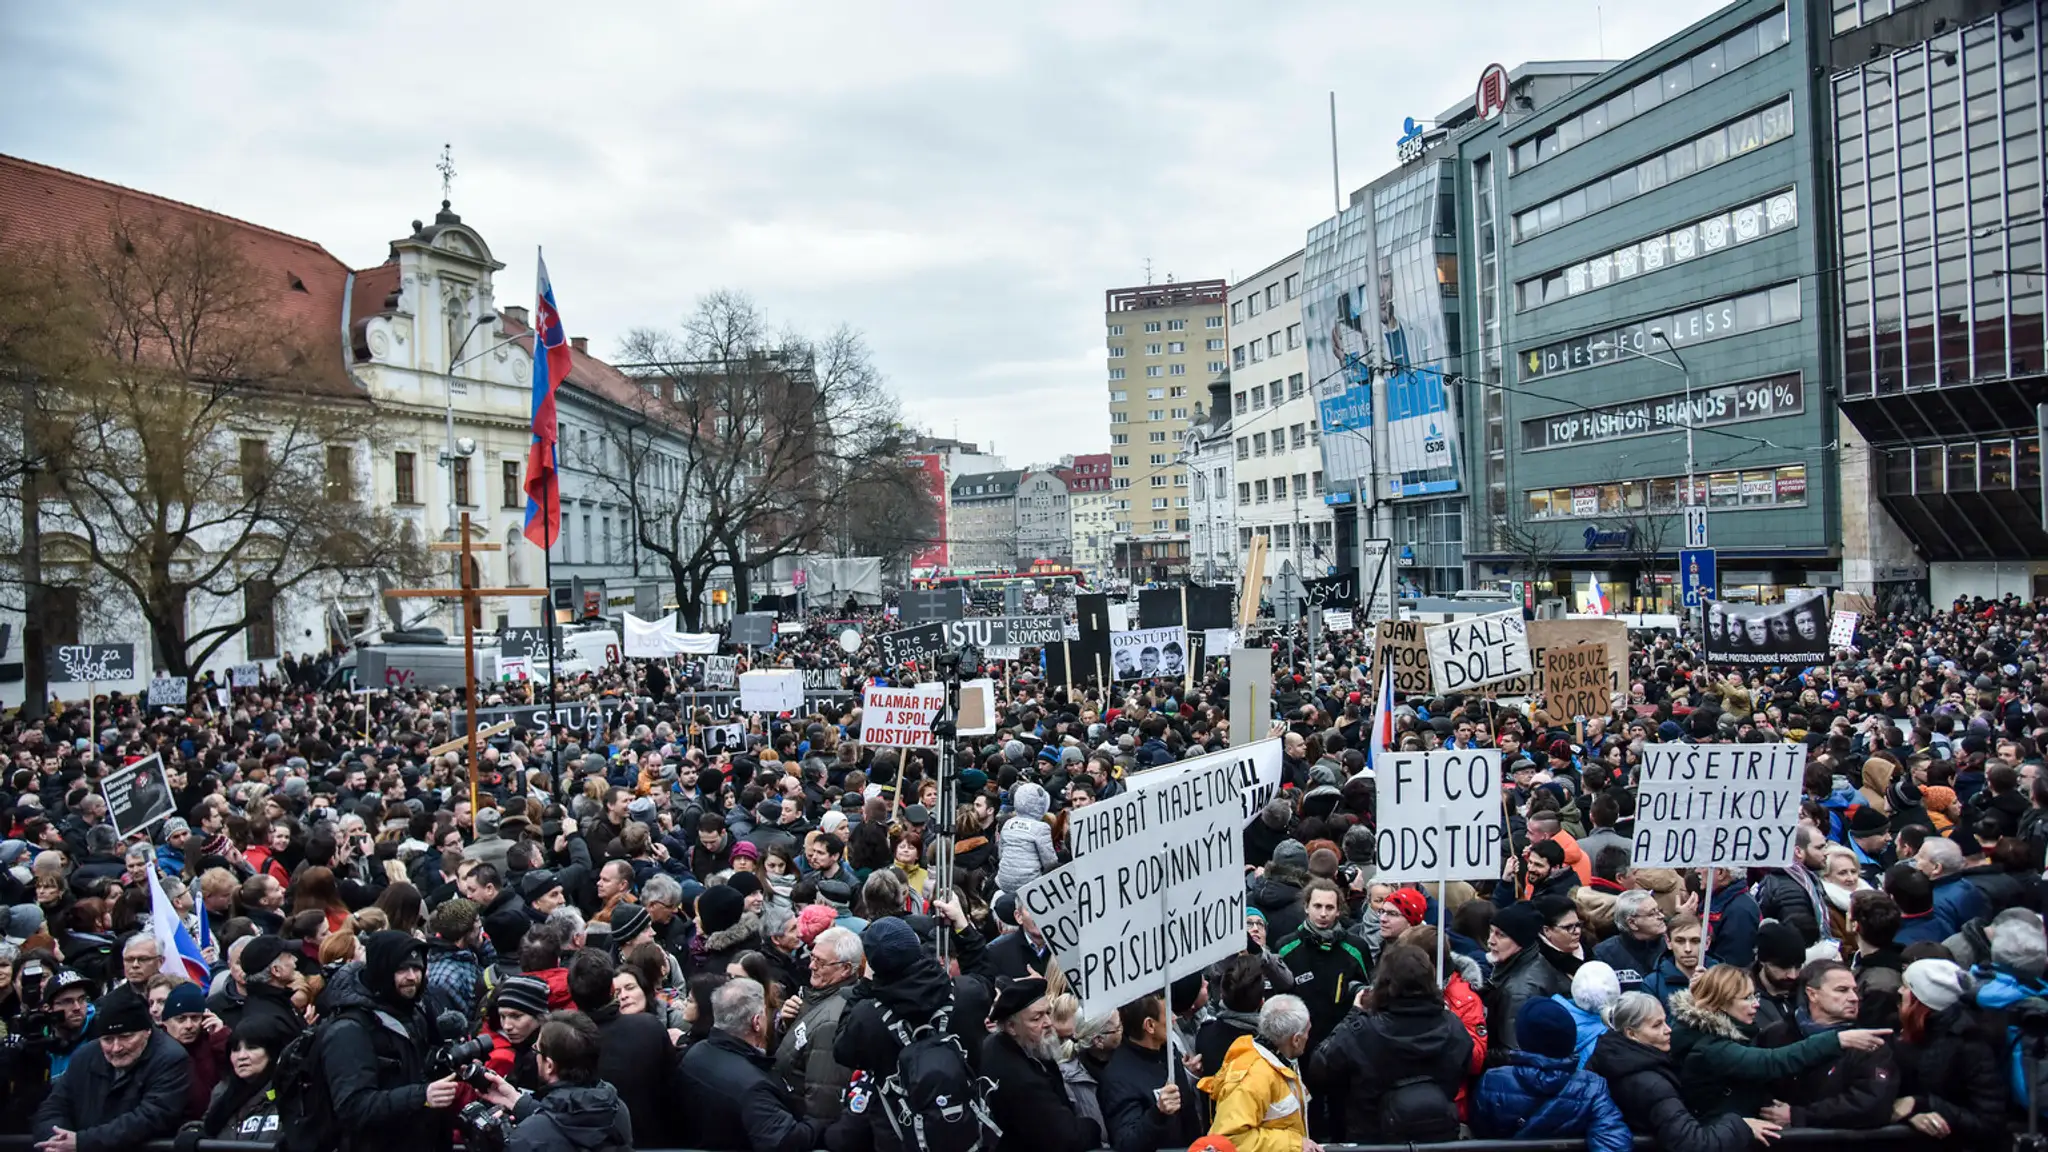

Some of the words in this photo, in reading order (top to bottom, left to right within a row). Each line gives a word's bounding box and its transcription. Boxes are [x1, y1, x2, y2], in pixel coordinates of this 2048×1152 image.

[1674, 309, 1732, 340] LESS
[1552, 420, 1579, 441] TOP
[1583, 408, 1651, 437] FASHION
[1656, 394, 1727, 425] BRANDS
[952, 620, 992, 647] STU
[1008, 629, 1061, 645] SLOVENSKO
[1012, 618, 1053, 629] SLUŠNÉ
[1113, 628, 1181, 648] ODSTÚPIŤ
[1383, 621, 1417, 642] JAN
[1448, 621, 1508, 655] KALI
[58, 646, 92, 663] STU
[101, 649, 120, 661] za
[882, 635, 920, 649] Sme
[1780, 651, 1825, 663] PROSTITÚTKY
[1444, 642, 1522, 689] DOLE
[1549, 652, 1585, 673] ROBO
[1587, 645, 1604, 667] UŽ
[70, 668, 132, 682] SLOVENSKO
[870, 691, 919, 710] KLAMÁR
[923, 696, 945, 711] FIC
[1550, 687, 1609, 722] SOROS
[885, 711, 894, 724] A
[898, 711, 931, 726] SPOL.
[1239, 758, 1260, 789] LL
[1644, 745, 1799, 781] VYŠETRIŤ
[1396, 754, 1490, 805] FICO
[1073, 789, 1148, 859] ZHABAŤ
[1157, 762, 1241, 825] MAJETOK
[1637, 785, 1789, 821] POLITIKOV
[1376, 810, 1501, 871] ODSTÚP
[1633, 829, 1653, 863] A
[1664, 828, 1697, 863] DO
[1710, 825, 1797, 863] BASY
[1078, 874, 1106, 928] AJ
[1118, 820, 1233, 909] RODINNÝM
[1083, 890, 1244, 1000] PRÍSLUŠNÍKOM
